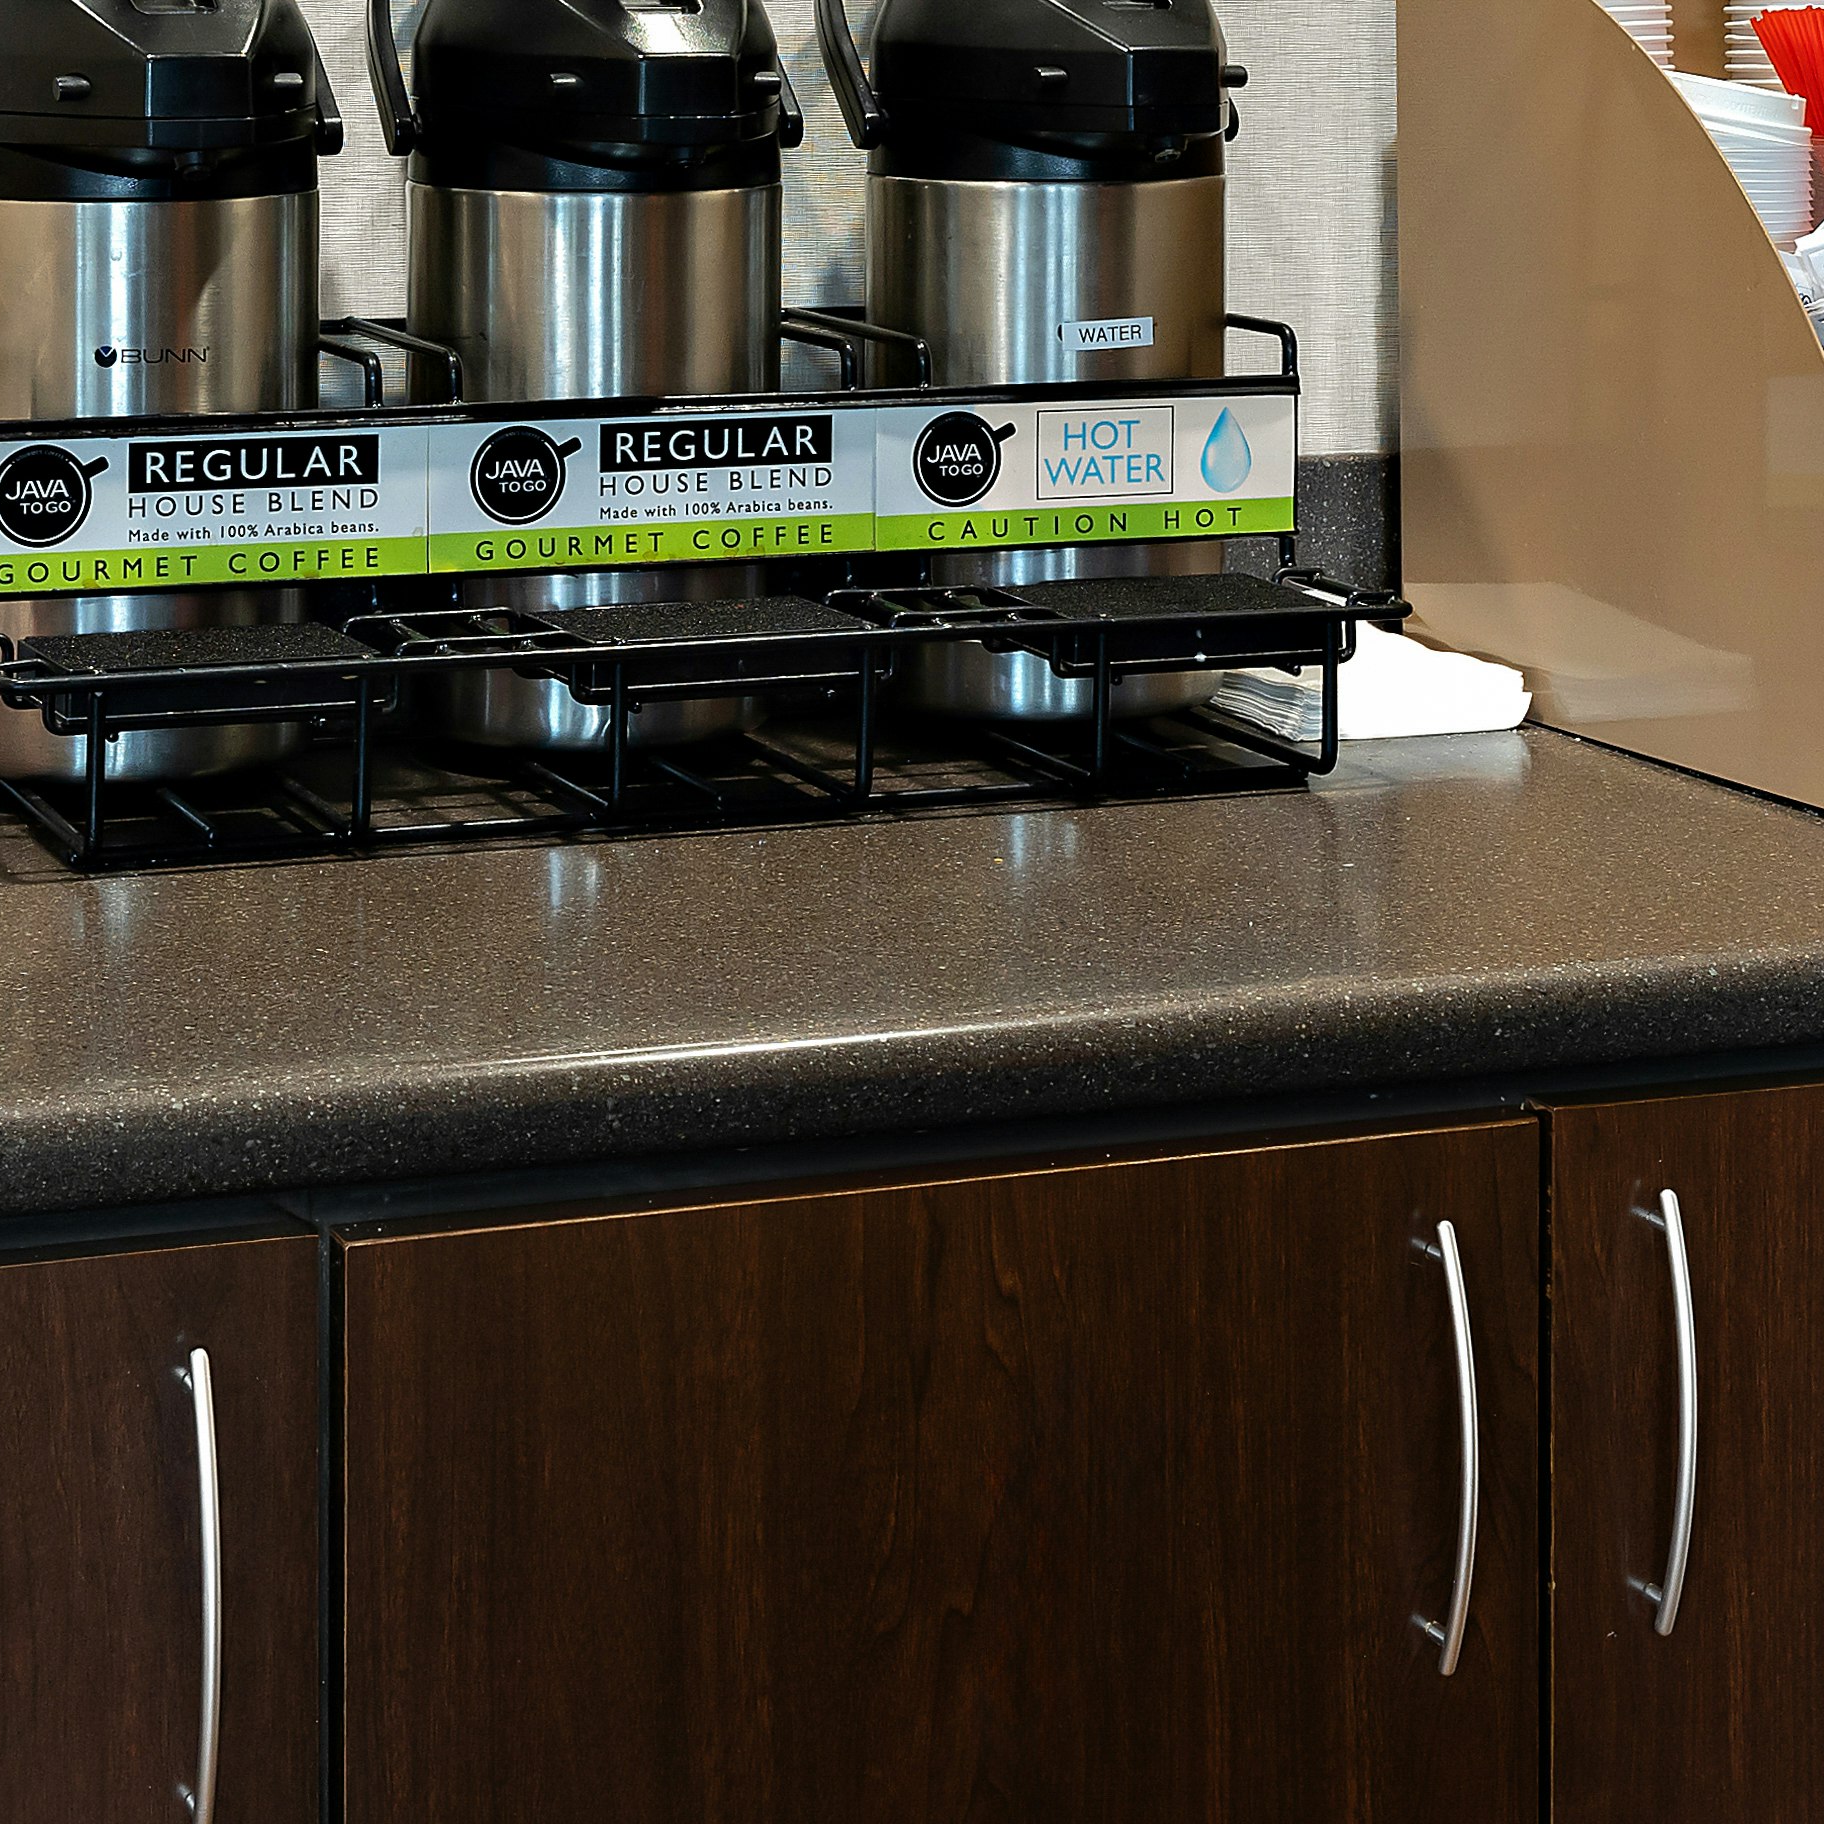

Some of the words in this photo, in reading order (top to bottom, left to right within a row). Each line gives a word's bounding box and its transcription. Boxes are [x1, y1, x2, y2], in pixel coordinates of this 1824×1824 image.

[1078, 324, 1143, 344] WATER
[121, 348, 207, 363] BUNN
[615, 425, 818, 465] REGULAR
[1063, 420, 1141, 451] HOT
[145, 445, 363, 484] REGULAR
[926, 443, 982, 464] JAVA
[485, 459, 544, 479] JAVA
[939, 465, 959, 476] TO
[961, 463, 983, 475] GO
[1044, 454, 1166, 486] WATER
[5, 479, 69, 500] JAVA
[499, 481, 521, 493] TO
[523, 480, 547, 492] GO
[599, 472, 709, 497] HOUSE
[730, 467, 832, 491] BLEND
[20, 502, 43, 514] TO
[45, 501, 71, 513] GO
[129, 493, 246, 518] HOUSE
[268, 488, 378, 512] BLEND
[599, 505, 637, 520] Made
[644, 504, 676, 518] with
[684, 501, 721, 516] 100%
[726, 499, 782, 515] Arabica
[788, 498, 833, 512] beans.
[129, 528, 171, 542] Made
[176, 526, 211, 541] with
[220, 524, 258, 539] 100%
[264, 522, 323, 537] Arabica
[331, 521, 379, 535] beans.
[928, 512, 1127, 541] CAUTION
[1164, 507, 1242, 530] HOT
[476, 531, 664, 561] GOURMET
[692, 524, 832, 550] COFFEE
[228, 547, 379, 574] COFFEE
